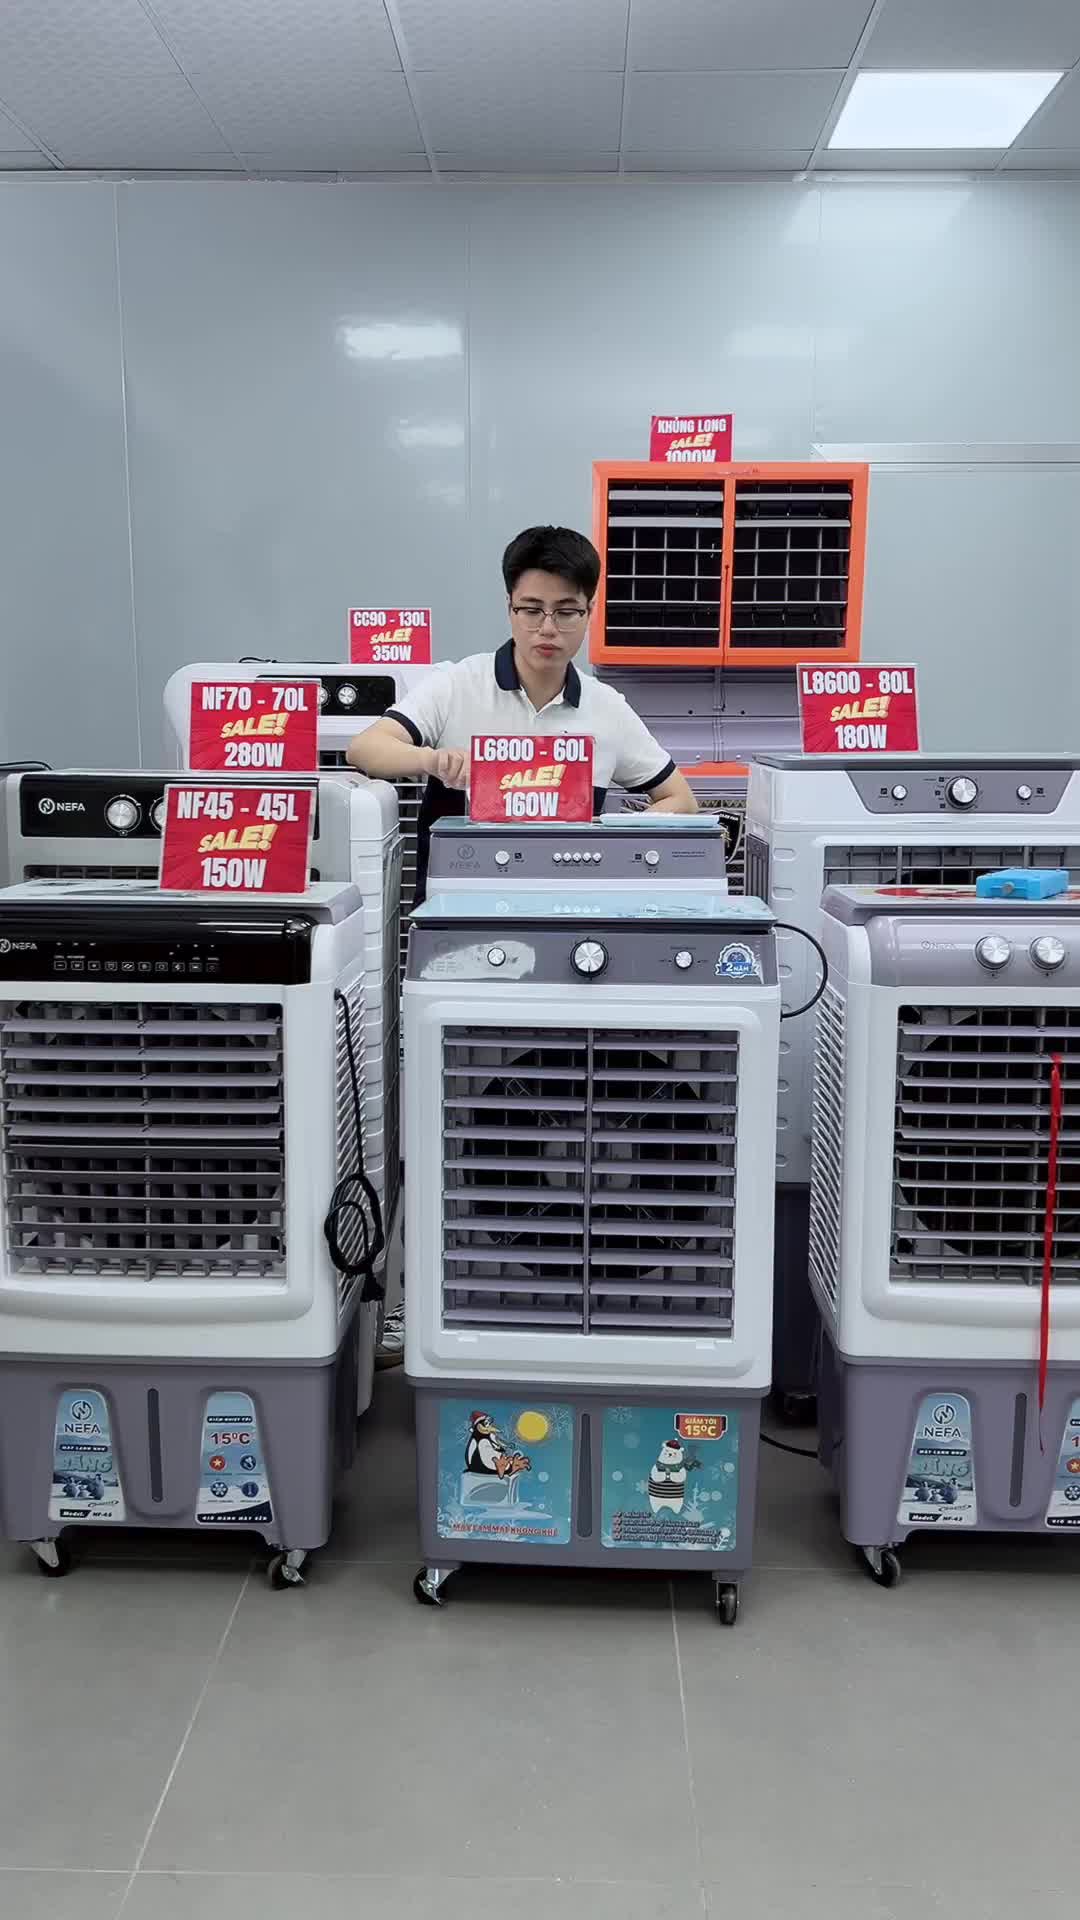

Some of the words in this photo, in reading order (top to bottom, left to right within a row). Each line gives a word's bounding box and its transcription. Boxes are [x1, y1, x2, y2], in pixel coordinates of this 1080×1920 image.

[698, 418, 727, 432] LONG
[669, 432, 714, 450] SALE!
[665, 449, 716, 462] 1000W
[353, 611, 386, 627] CC90
[399, 611, 427, 627] 130L
[369, 627, 413, 644] SALE!
[372, 645, 412, 661] 350W
[802, 670, 860, 694] L8600
[879, 670, 912, 694] 80L
[202, 686, 252, 711] NF70
[272, 687, 308, 711] 70L
[830, 695, 891, 722] SALE!
[220, 712, 290, 738] SALE!
[835, 724, 887, 749] 180W
[224, 742, 284, 767] 280W
[474, 738, 534, 761] L6800
[553, 738, 589, 762] 60L
[499, 764, 567, 790] SALE!
[56, 803, 86, 812] NEFA
[177, 791, 234, 820] NF45
[256, 792, 299, 822] 45L
[503, 791, 559, 816] 160W
[197, 823, 278, 853] SALE!
[201, 857, 267, 888] 150W
[12, 942, 38, 951] NEFA
[726, 962, 734, 972] 2
[64, 1423, 101, 1434] NEFA
[924, 1427, 961, 1438] NEFA
